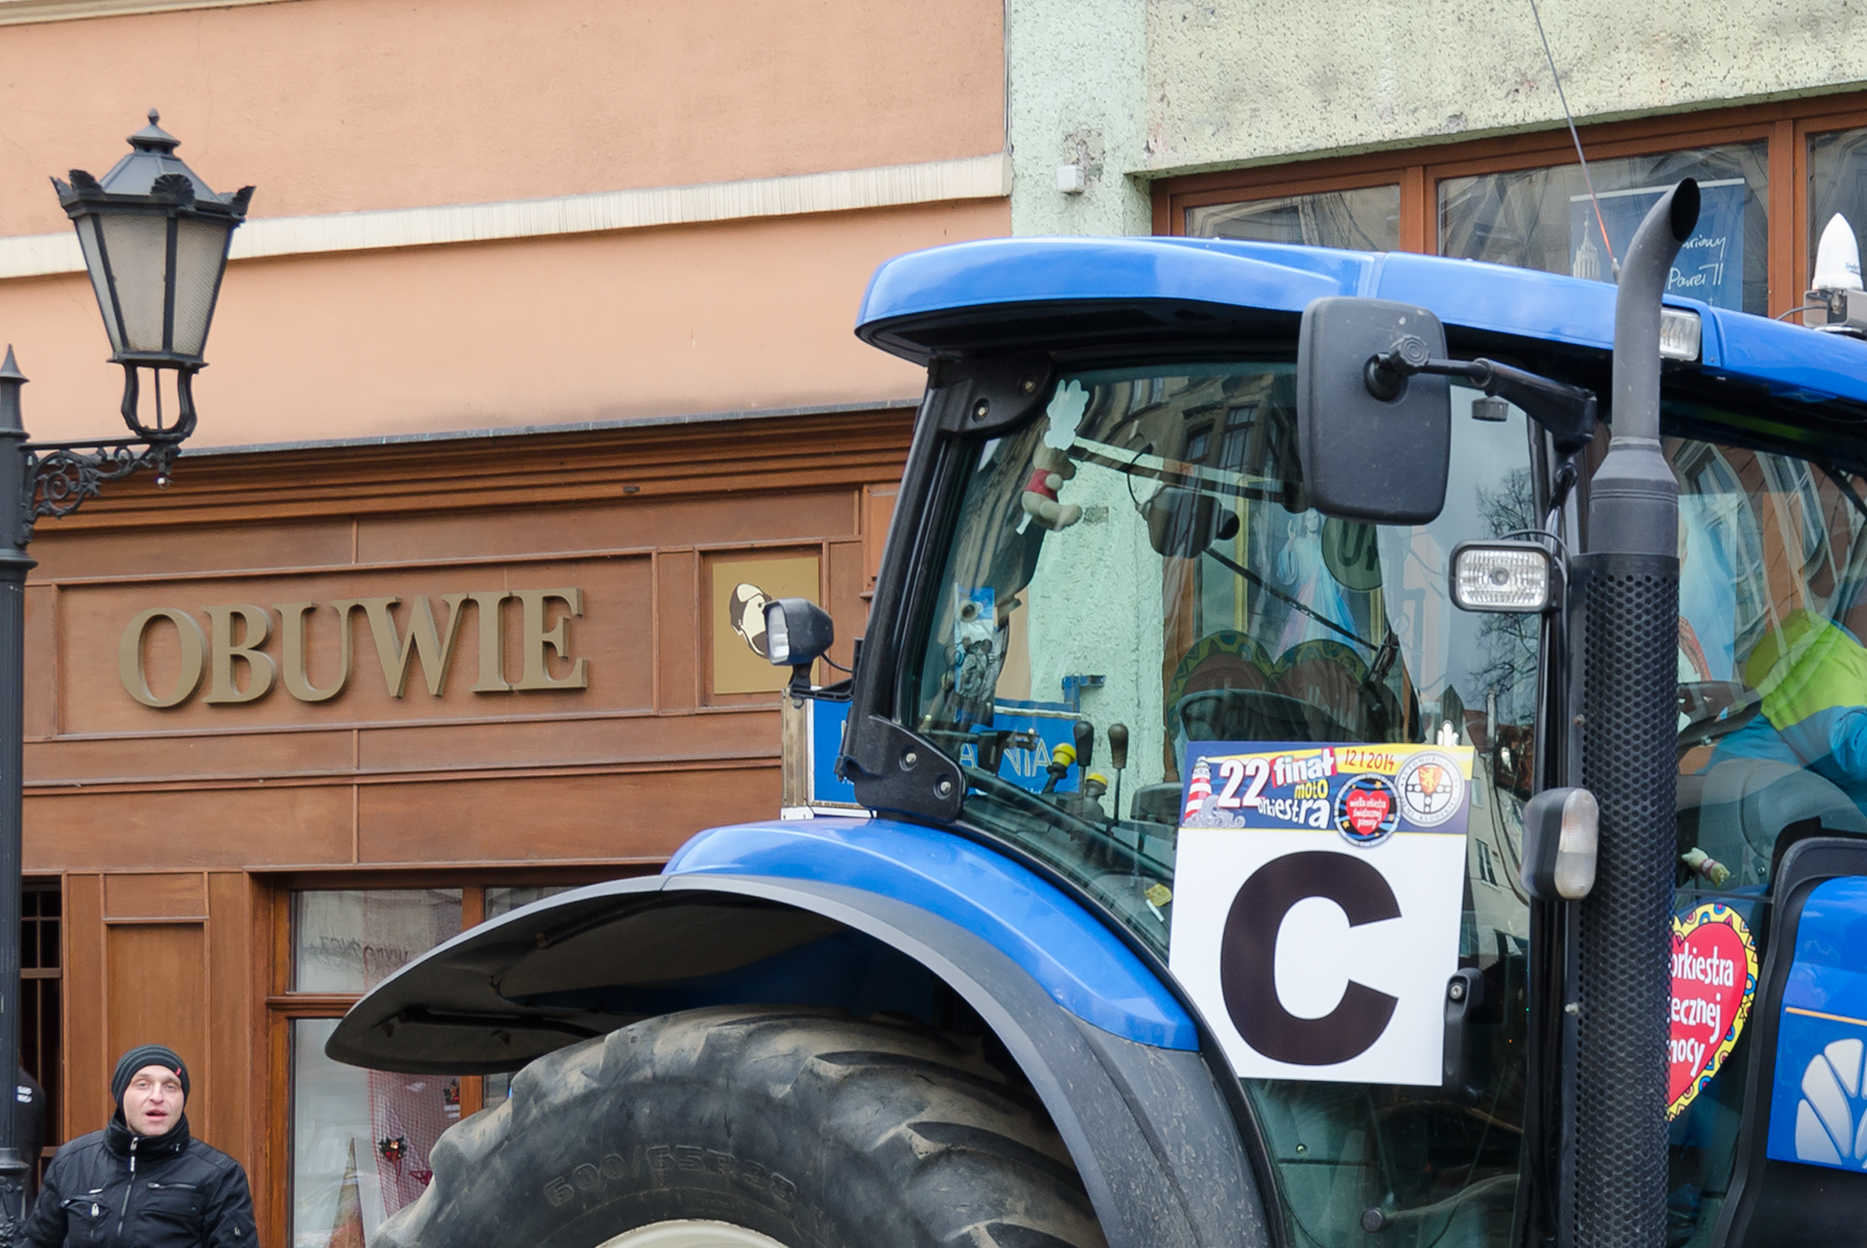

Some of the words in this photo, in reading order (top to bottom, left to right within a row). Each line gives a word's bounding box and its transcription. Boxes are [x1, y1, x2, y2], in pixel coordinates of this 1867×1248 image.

[118, 587, 588, 708] OBUWIE
[1217, 757, 1270, 808] 22
[1294, 778, 1329, 800] moto
[1220, 850, 1403, 1066] C
